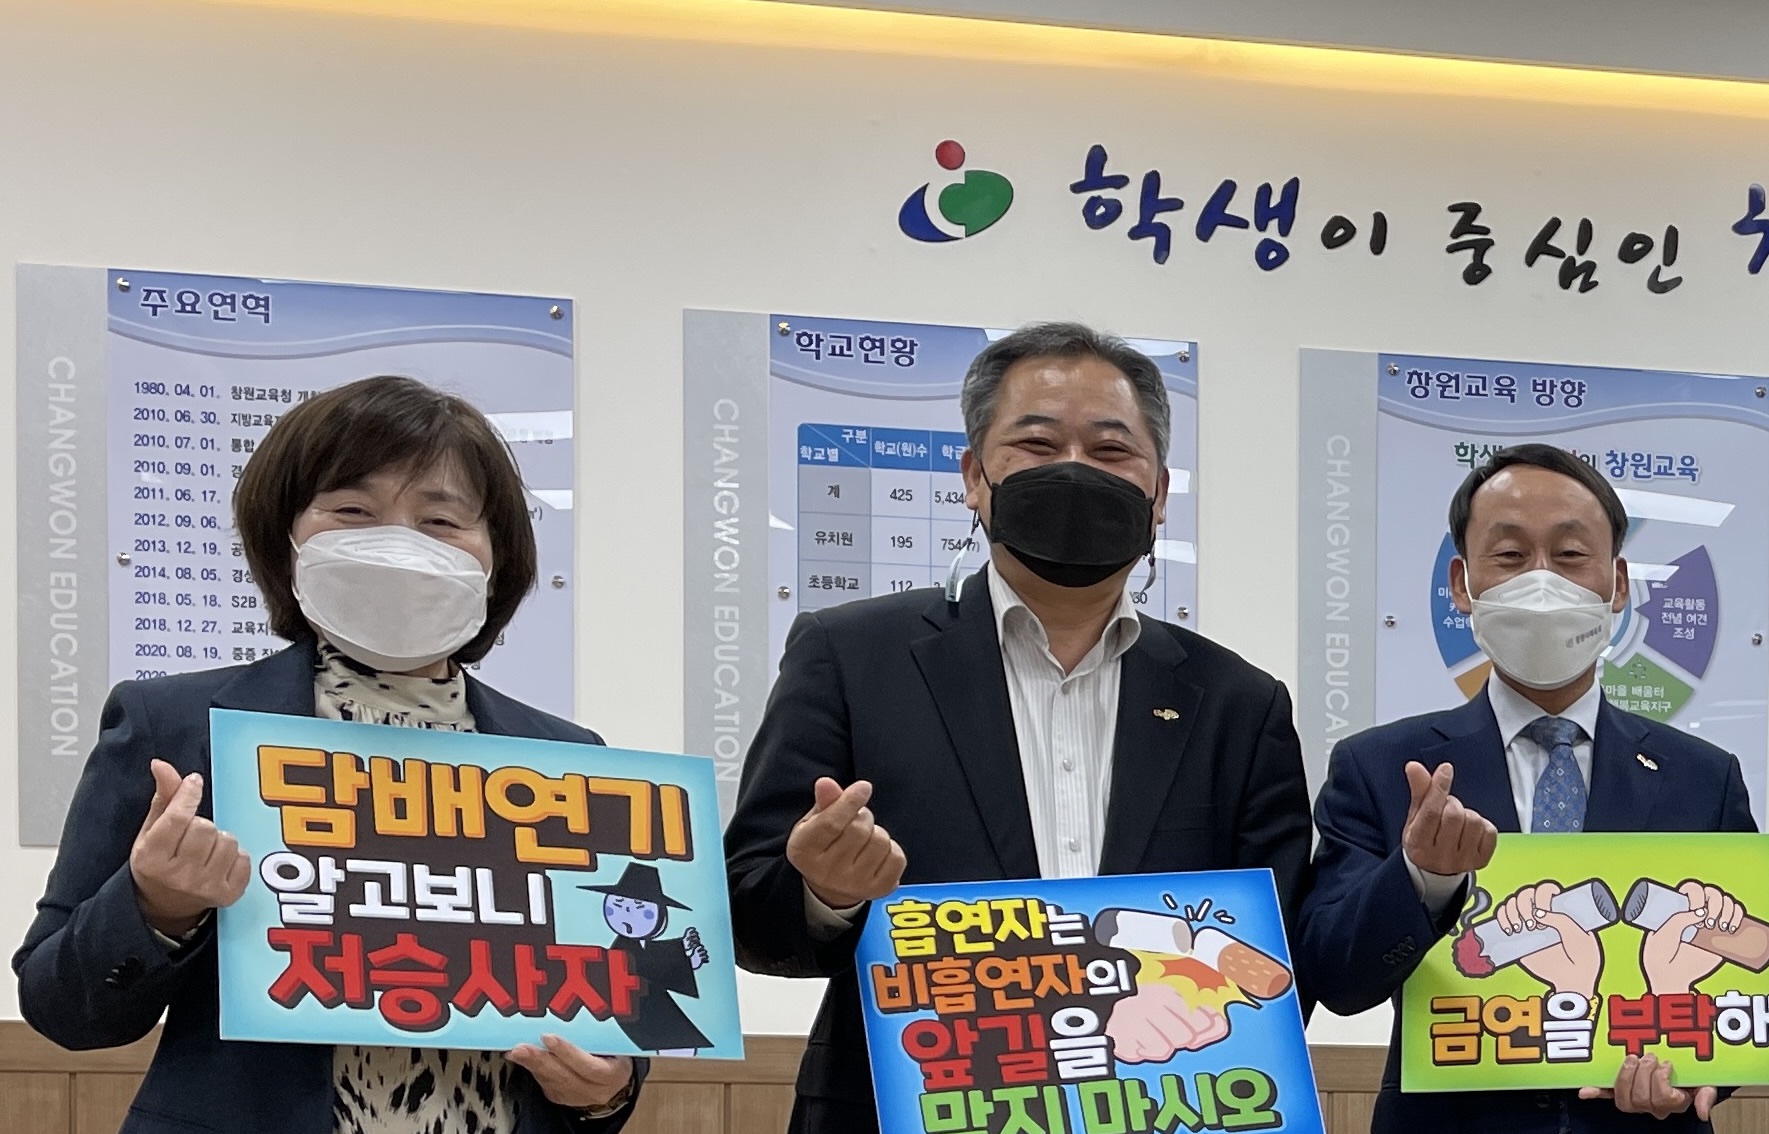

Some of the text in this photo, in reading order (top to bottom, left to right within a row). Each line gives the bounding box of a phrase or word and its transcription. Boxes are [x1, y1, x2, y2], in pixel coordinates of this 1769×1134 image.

[1066, 143, 1388, 272] 학생이
[1446, 201, 1682, 294] 중심인
[139, 287, 272, 324] 주요연혁
[794, 330, 919, 368] 학교현황
[134, 382, 170, 396] 1980.
[174, 384, 195, 398] 04.
[200, 386, 220, 399] 01.
[1406, 368, 1587, 410] 창원교육 방향
[134, 408, 170, 423] 2010.
[174, 410, 195, 424] 06.
[200, 412, 221, 425] 30.
[134, 434, 170, 449] 2010.
[174, 436, 195, 450] 07.
[200, 438, 221, 452] 01.
[841, 429, 867, 444] 구분
[800, 447, 839, 462] 학교별
[874, 440, 928, 458] 학교(원)수
[134, 460, 170, 475] 2010.
[174, 462, 195, 476] 09.
[200, 464, 221, 478] 01.
[1604, 449, 1699, 481] 창원교육
[134, 487, 221, 504] 2011. 06. 17.
[827, 484, 840, 498] 계
[890, 489, 913, 501] 425
[134, 513, 170, 527] 2012.
[175, 515, 195, 529] 09.
[201, 516, 221, 530] 06.
[1326, 434, 1350, 621] CHANGWON
[814, 531, 853, 546] 유치원
[890, 536, 913, 549] 195
[47, 355, 79, 757] CHANGWON EDUCATION
[134, 539, 170, 553] 2013.
[176, 541, 195, 555] 12.
[202, 542, 221, 556] 19.
[134, 566, 170, 580] 2014.
[175, 567, 195, 581] 08.
[201, 568, 221, 582] 05.
[808, 575, 859, 590] 초등학교
[713, 398, 741, 782] CHANGWON EDUCATION
[135, 592, 257, 608] 2018. 05. 18. S2B
[135, 618, 170, 632] 2018.
[177, 620, 196, 633] 12.
[201, 621, 221, 634] 27.
[1686, 613, 1707, 626] 여건
[1673, 627, 1695, 640] 조성
[135, 644, 171, 658] 2020.
[176, 646, 196, 659] 08.
[203, 647, 222, 660] 19.
[257, 744, 693, 870] 담배연기
[259, 851, 550, 927] 알고보니
[886, 898, 1089, 957] 흡연자는
[267, 927, 641, 1033] 저승사자
[871, 954, 1138, 1015] 비흡연자의
[1430, 991, 1597, 1065] 금연을
[901, 1006, 1112, 1091] 앞길을
